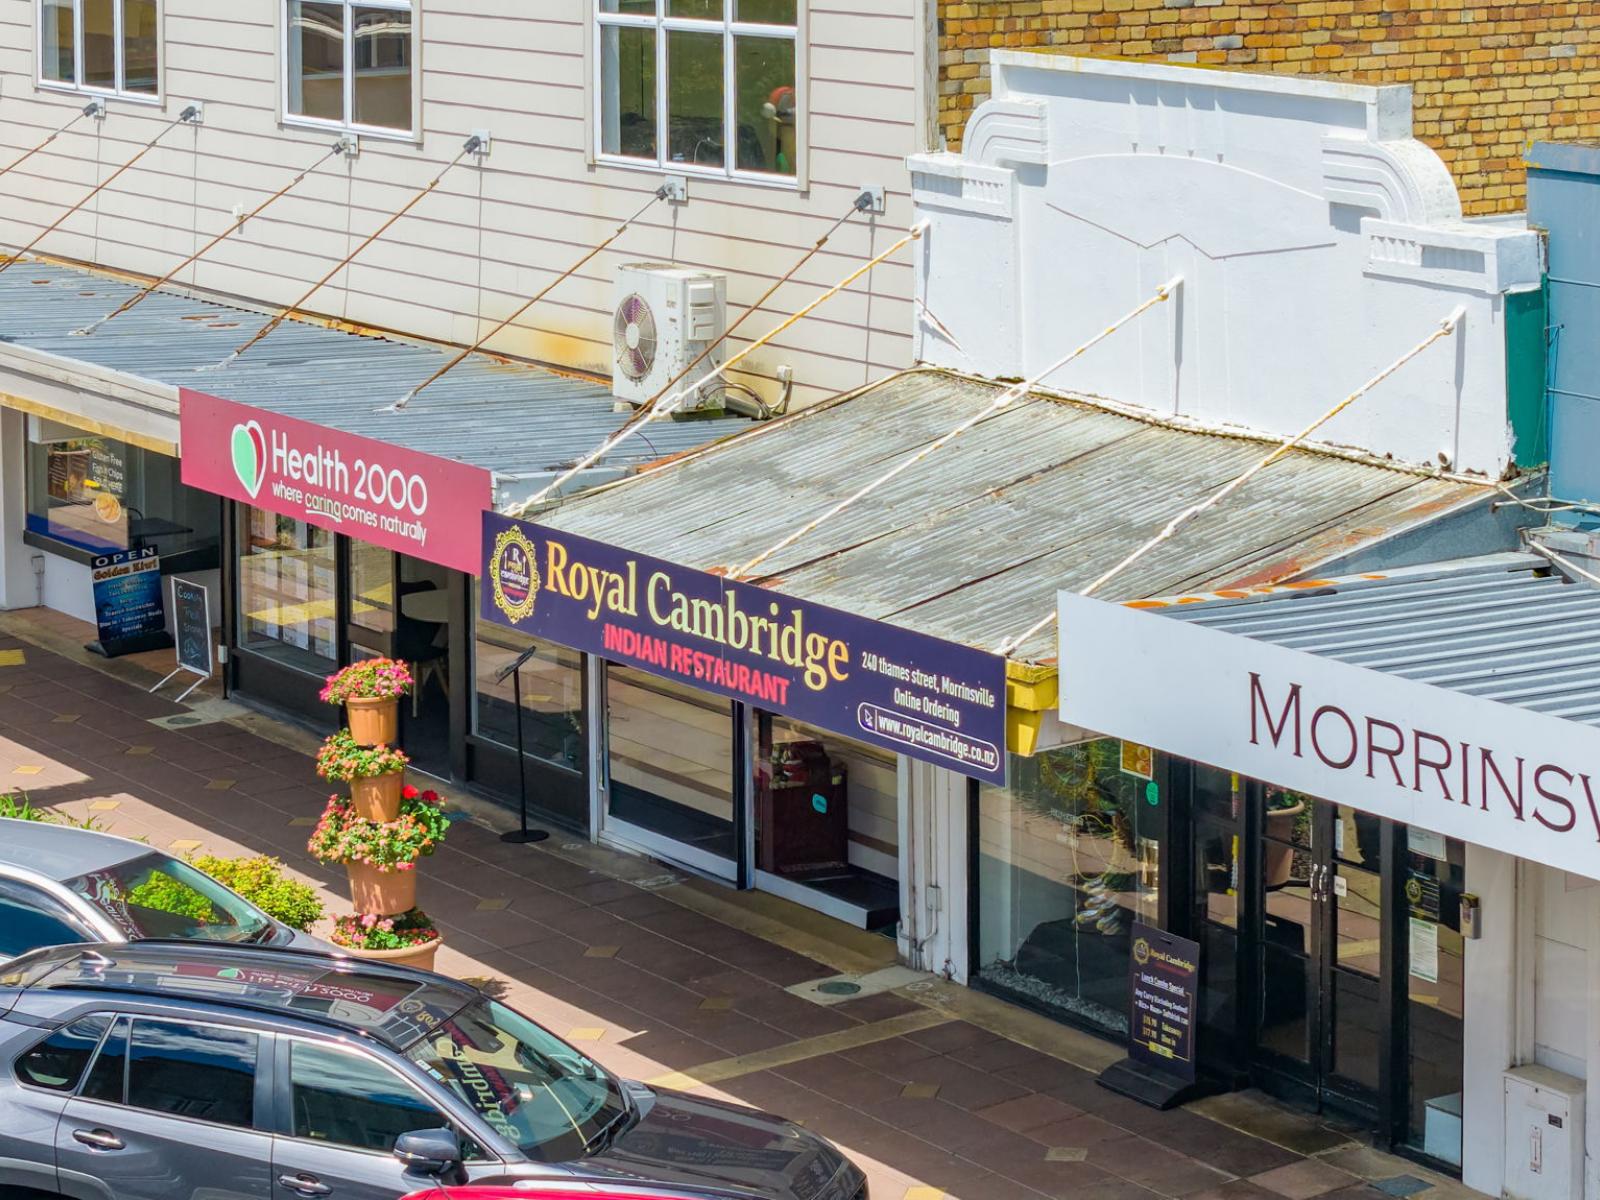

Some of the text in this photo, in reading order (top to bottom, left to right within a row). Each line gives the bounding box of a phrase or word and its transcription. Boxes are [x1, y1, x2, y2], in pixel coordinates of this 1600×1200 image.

[110, 453, 123, 467] Free
[272, 429, 428, 516] Health 2000
[272, 480, 428, 547] where caring comes naturally
[95, 547, 155, 567] OPEN
[545, 540, 849, 691] Royal Cambridge
[604, 622, 790, 705] INDIAN RESTAURANT
[862, 651, 995, 708] 240 thames street, Morrinsville
[894, 687, 960, 728] Online Ordering
[879, 715, 995, 766] www.royalcambridge.co.nz
